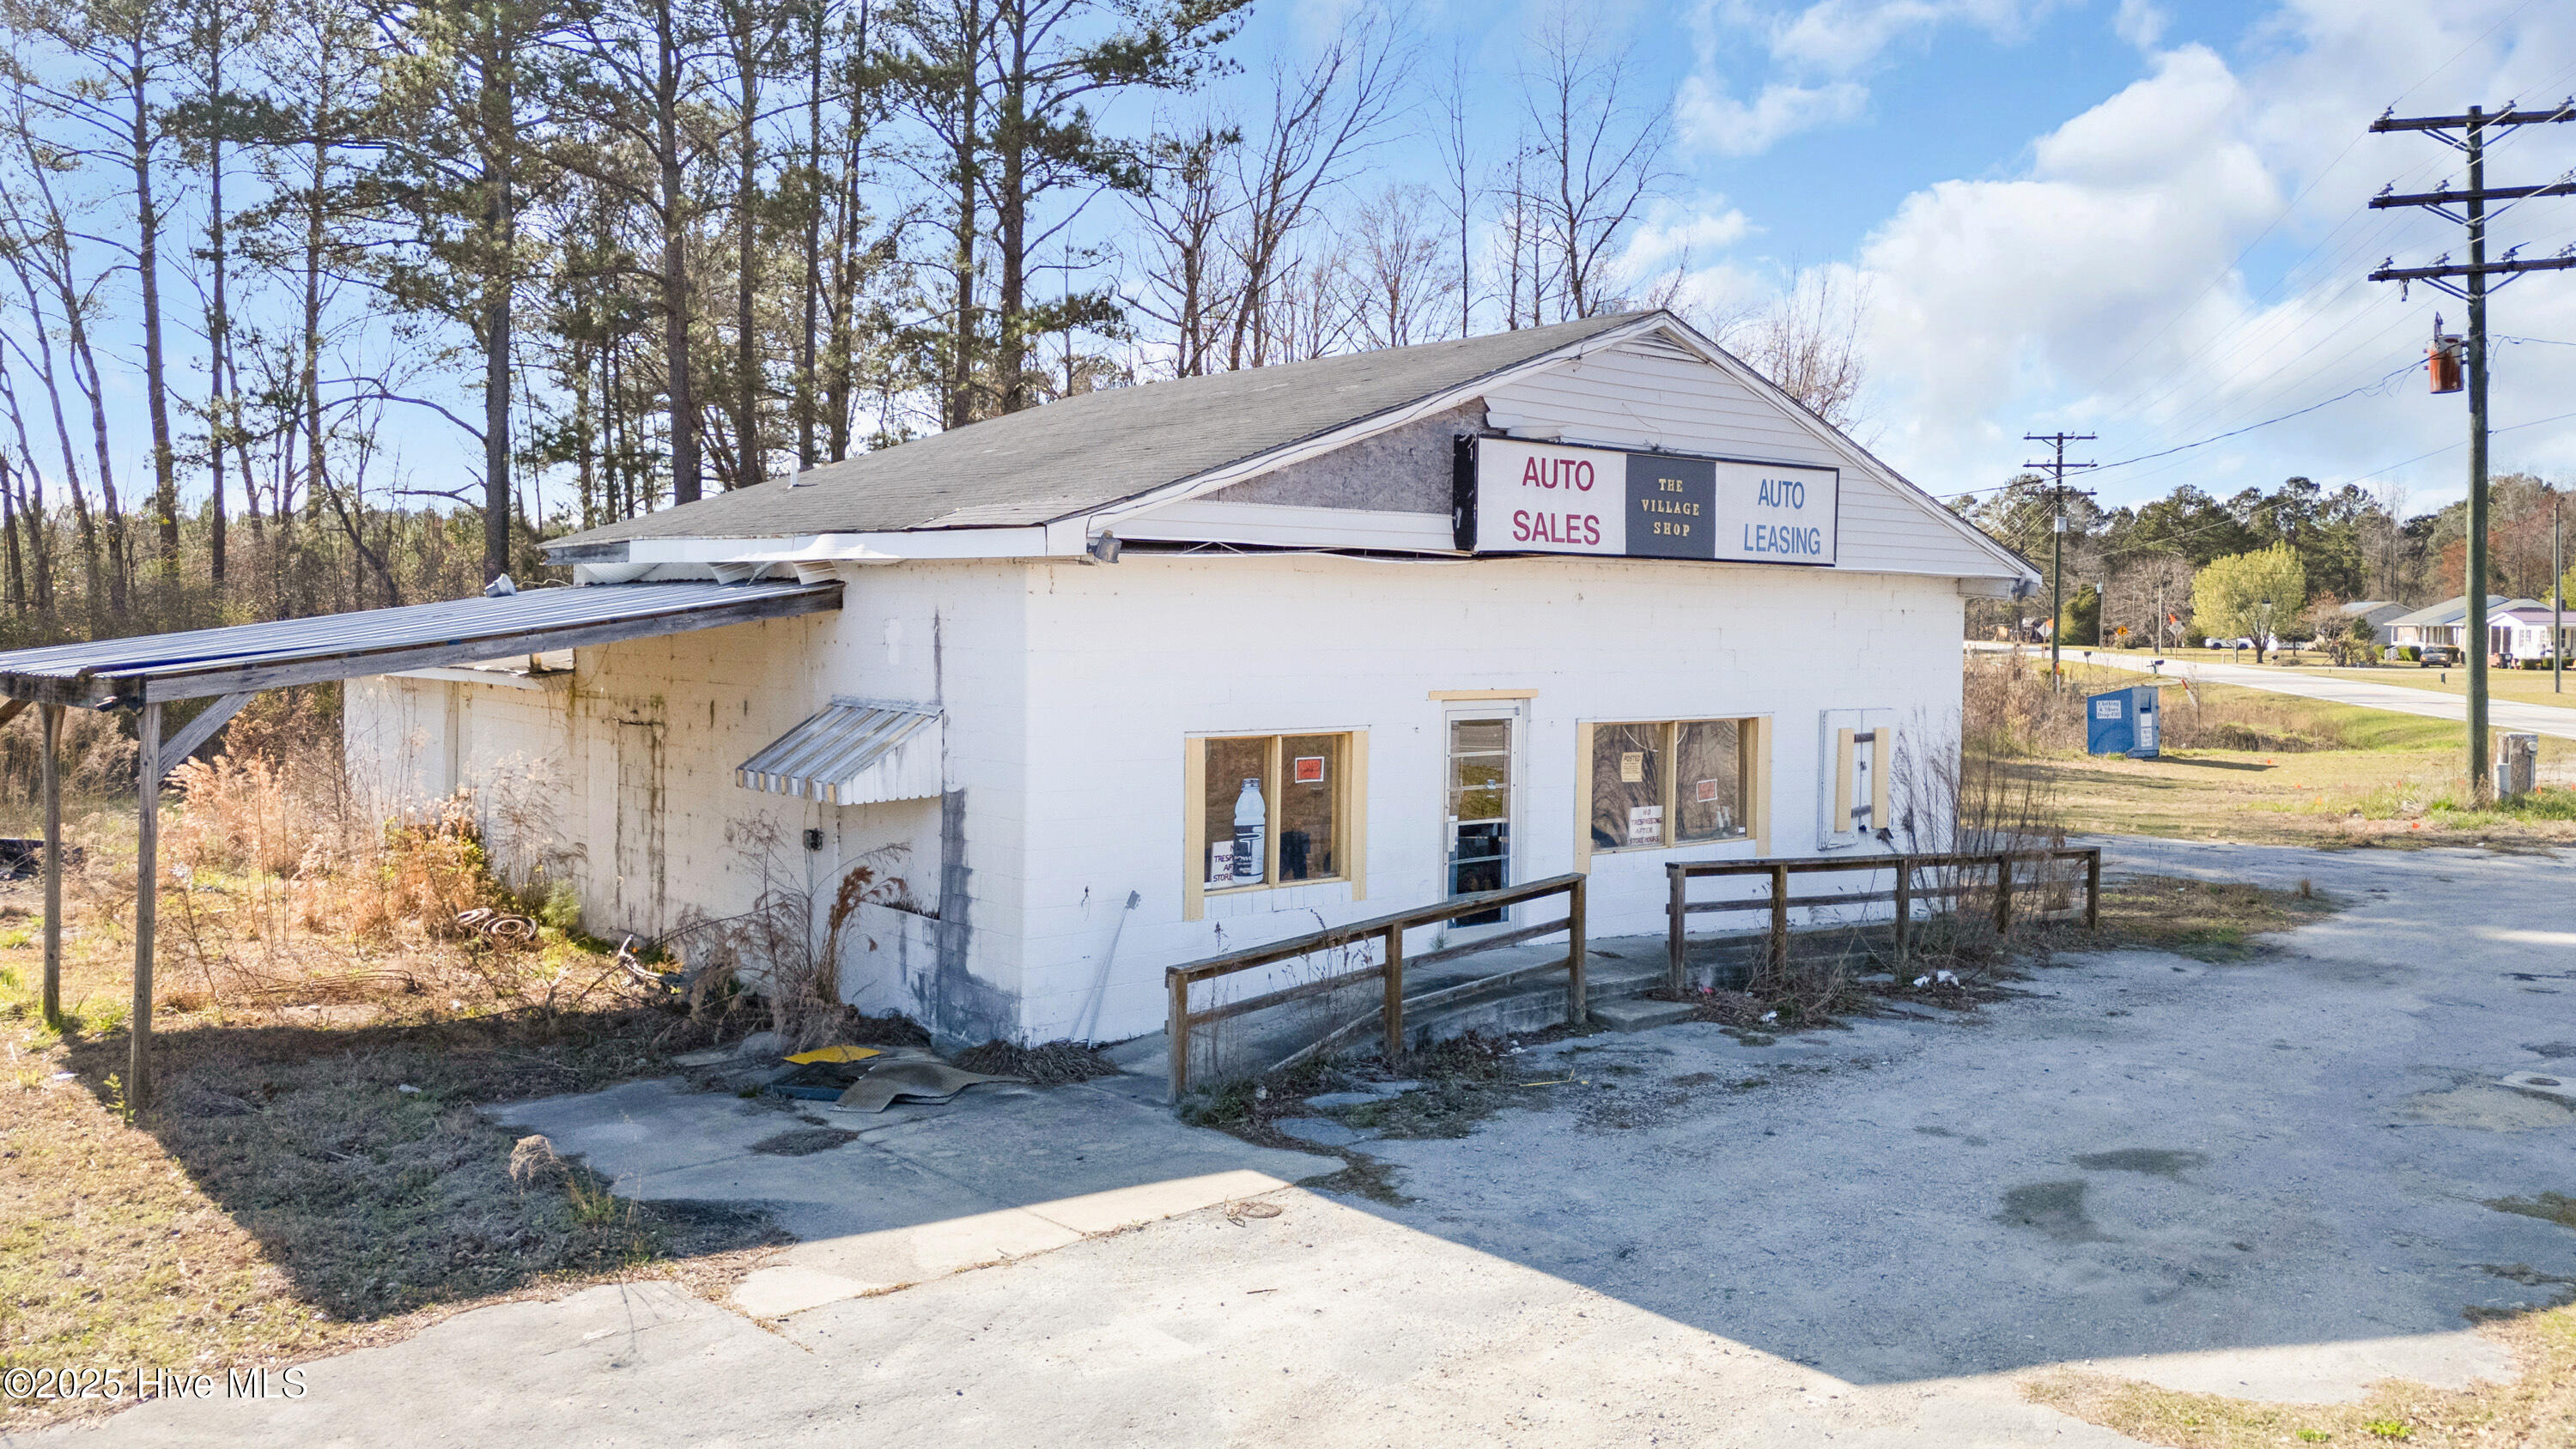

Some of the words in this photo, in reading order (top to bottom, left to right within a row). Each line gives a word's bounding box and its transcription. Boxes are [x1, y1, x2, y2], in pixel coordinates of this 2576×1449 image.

[1522, 456, 1595, 492] AUTO
[1658, 477, 1684, 494] THE
[1758, 478, 1805, 510] AUTO
[1641, 498, 1700, 517] VILLAGE
[1512, 509, 1601, 546] SALES
[1653, 521, 1691, 537] SHOP
[1744, 523, 1821, 555] LEASING
[1212, 873, 1233, 882] STORE
